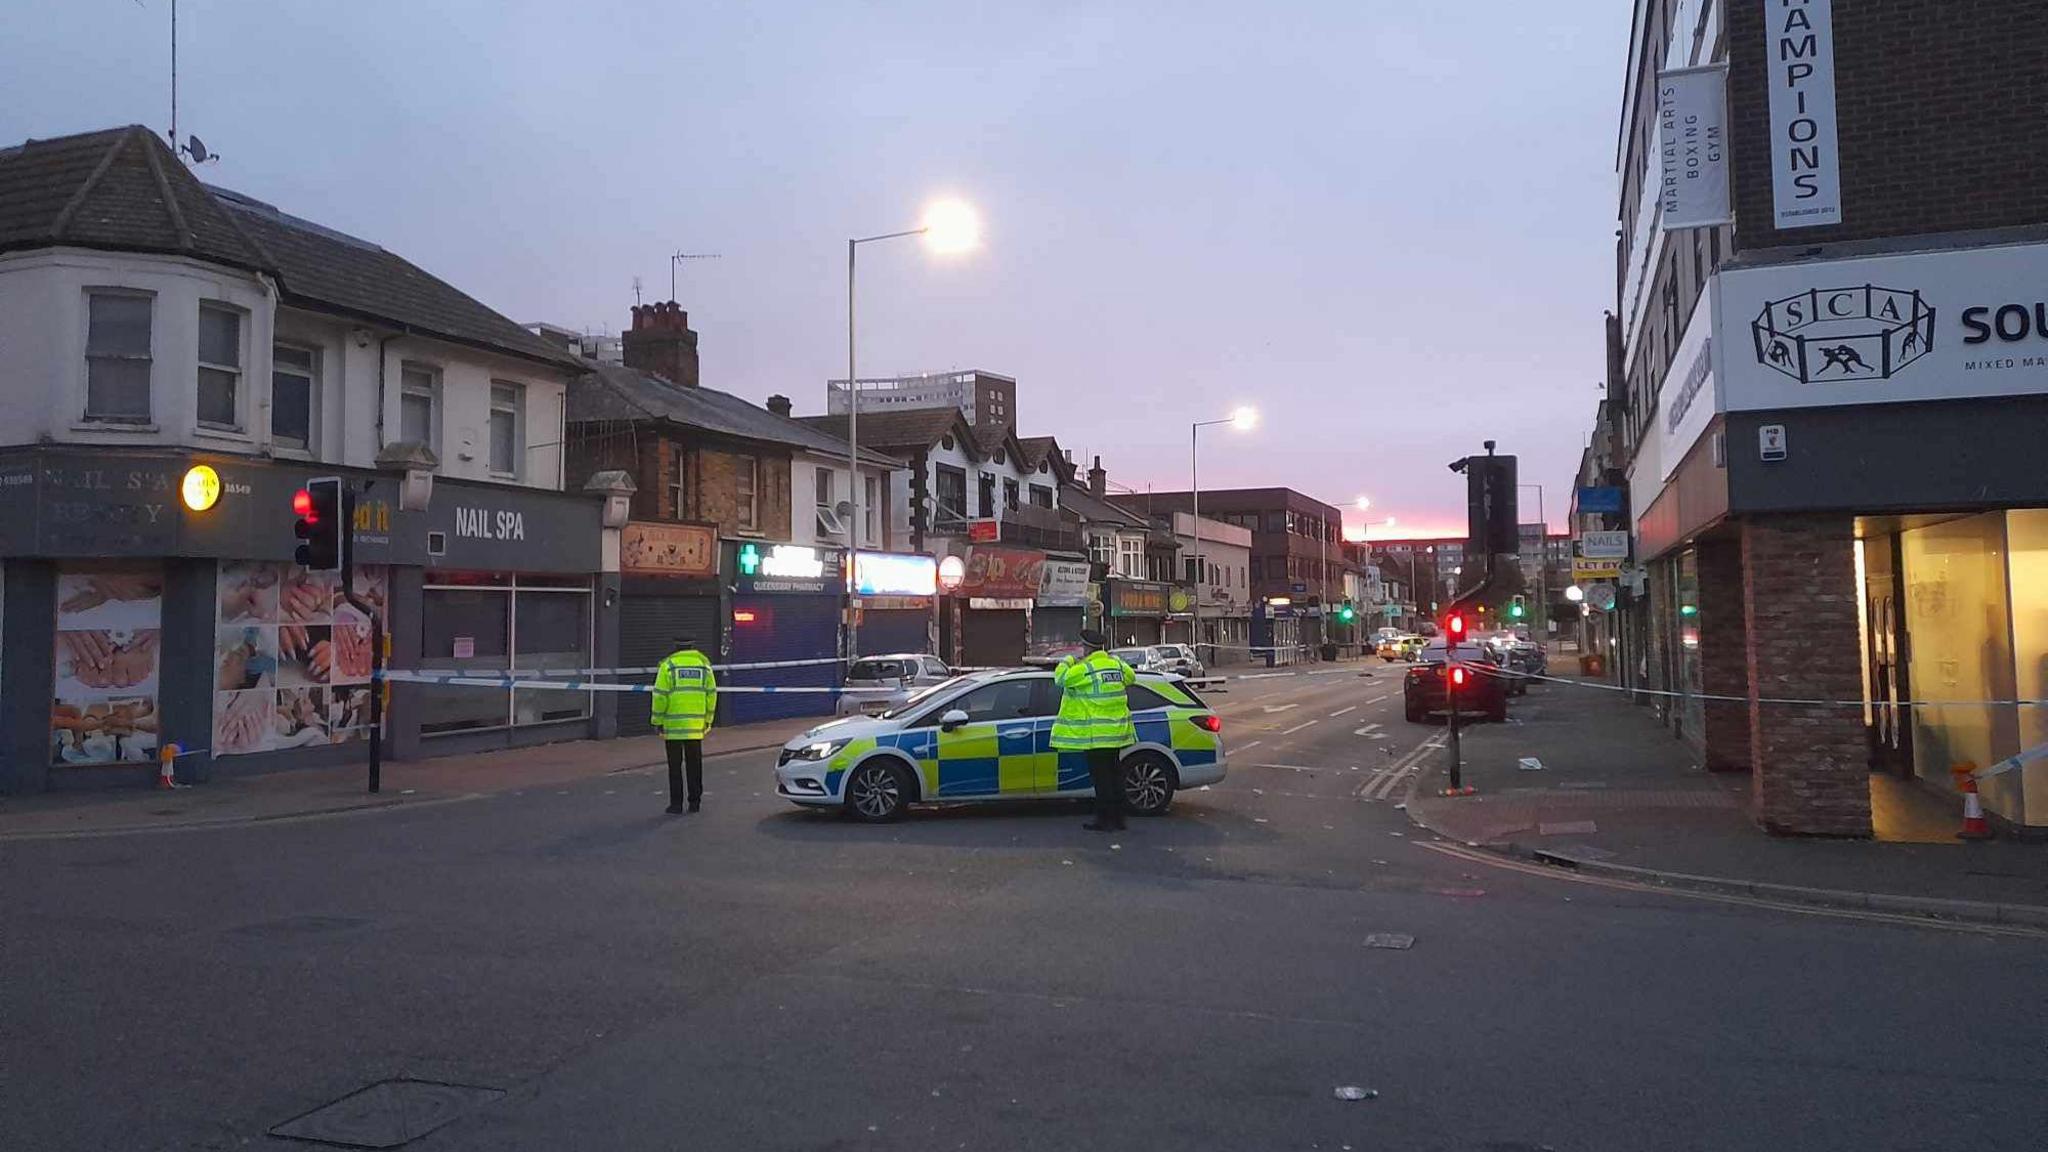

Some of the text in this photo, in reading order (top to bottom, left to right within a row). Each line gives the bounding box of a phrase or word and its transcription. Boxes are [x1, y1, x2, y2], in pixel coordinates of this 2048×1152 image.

[1662, 87, 1678, 213] MARTIAL ARTS
[1685, 115, 1698, 179] BOXING
[1707, 126, 1720, 162] GYM
[1965, 359, 2014, 370] MIXED
[456, 507, 524, 541] NAIL SPA
[1587, 536, 1625, 547] NAILS
[1577, 561, 1619, 569] LET BY
[1103, 673, 1121, 681] POLICE
